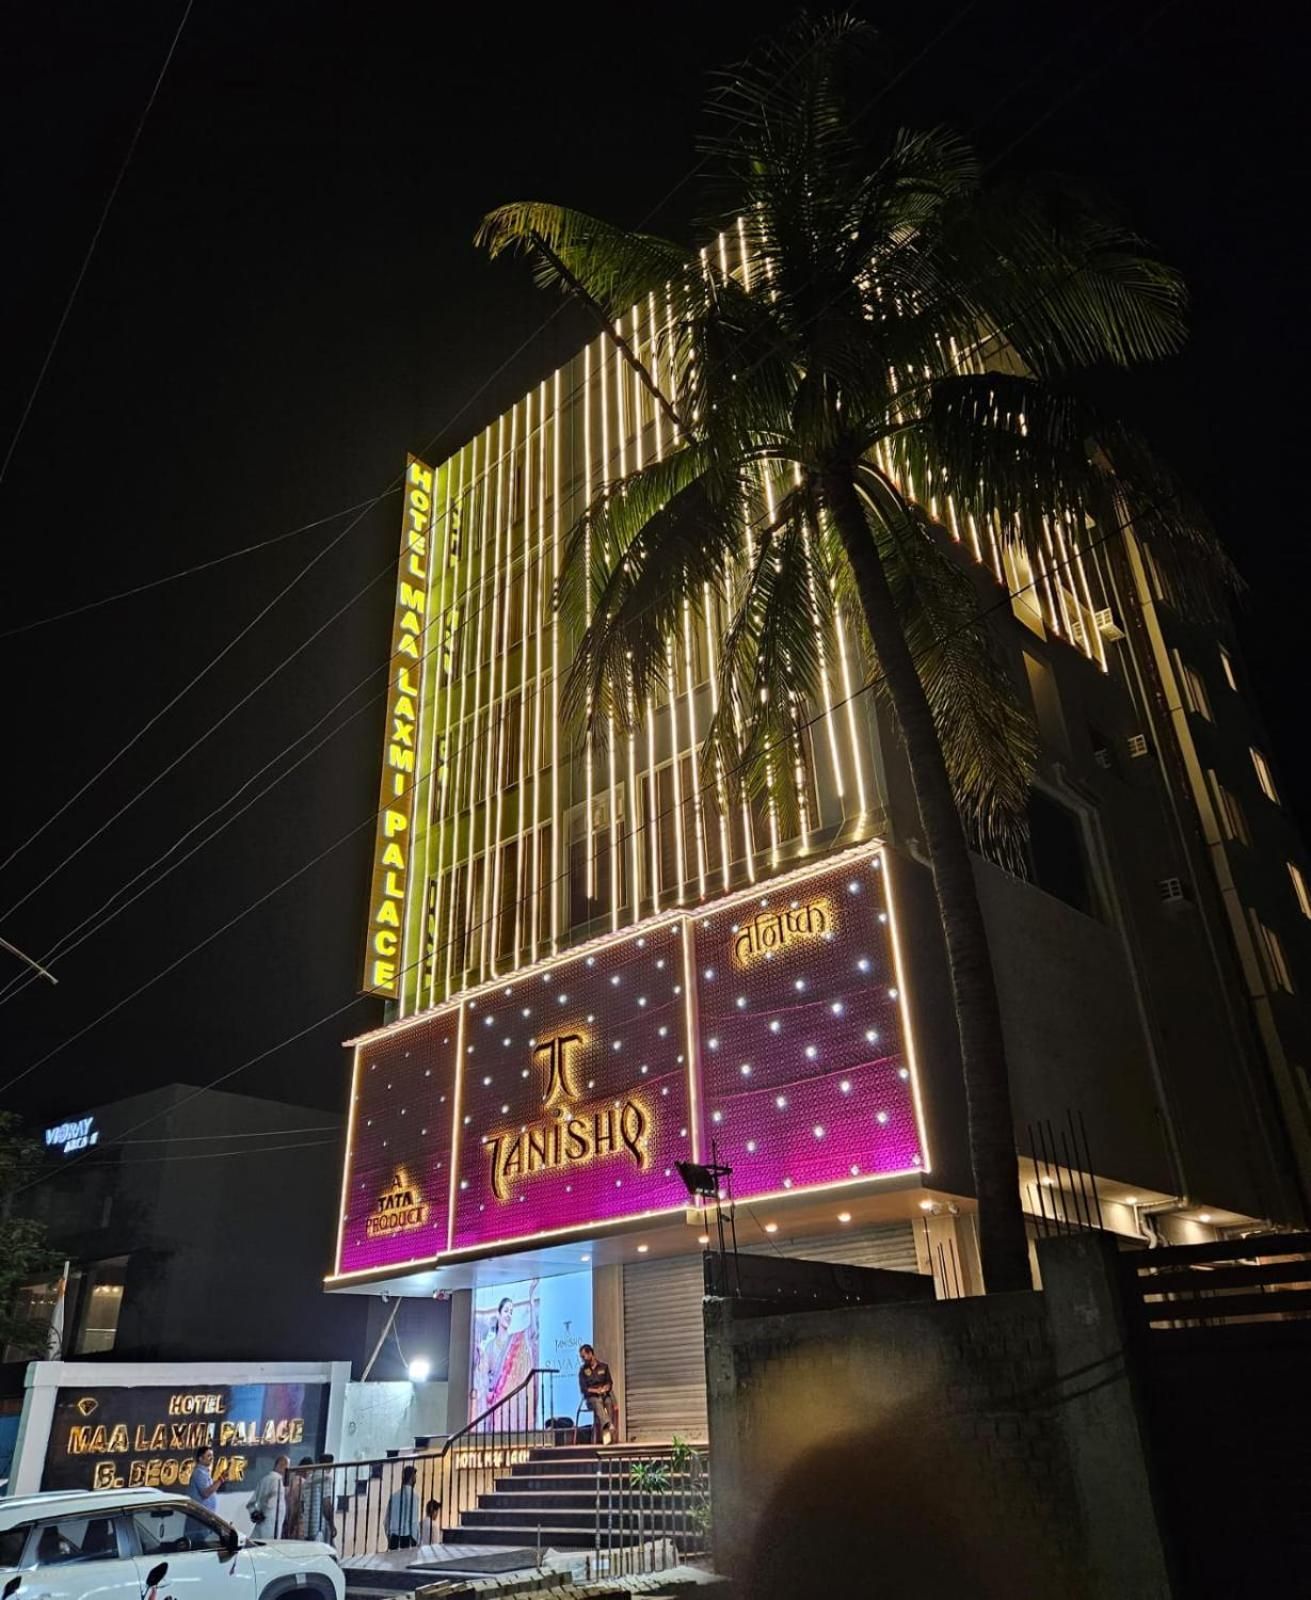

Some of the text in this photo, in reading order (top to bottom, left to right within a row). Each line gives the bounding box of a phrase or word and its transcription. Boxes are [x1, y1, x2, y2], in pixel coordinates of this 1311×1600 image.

[373, 462, 432, 990] HOTEL MAA LAXMI PALACE
[736, 900, 826, 964] तनिष्क
[483, 1101, 644, 1200] TANISHQ
[378, 1190, 414, 1213] TATA
[366, 1207, 425, 1234] PRODUCT
[168, 1394, 226, 1416] HOTEL
[67, 1418, 304, 1454] MAA LAXMI PALACE
[128, 1455, 248, 1488] DEOGAR
